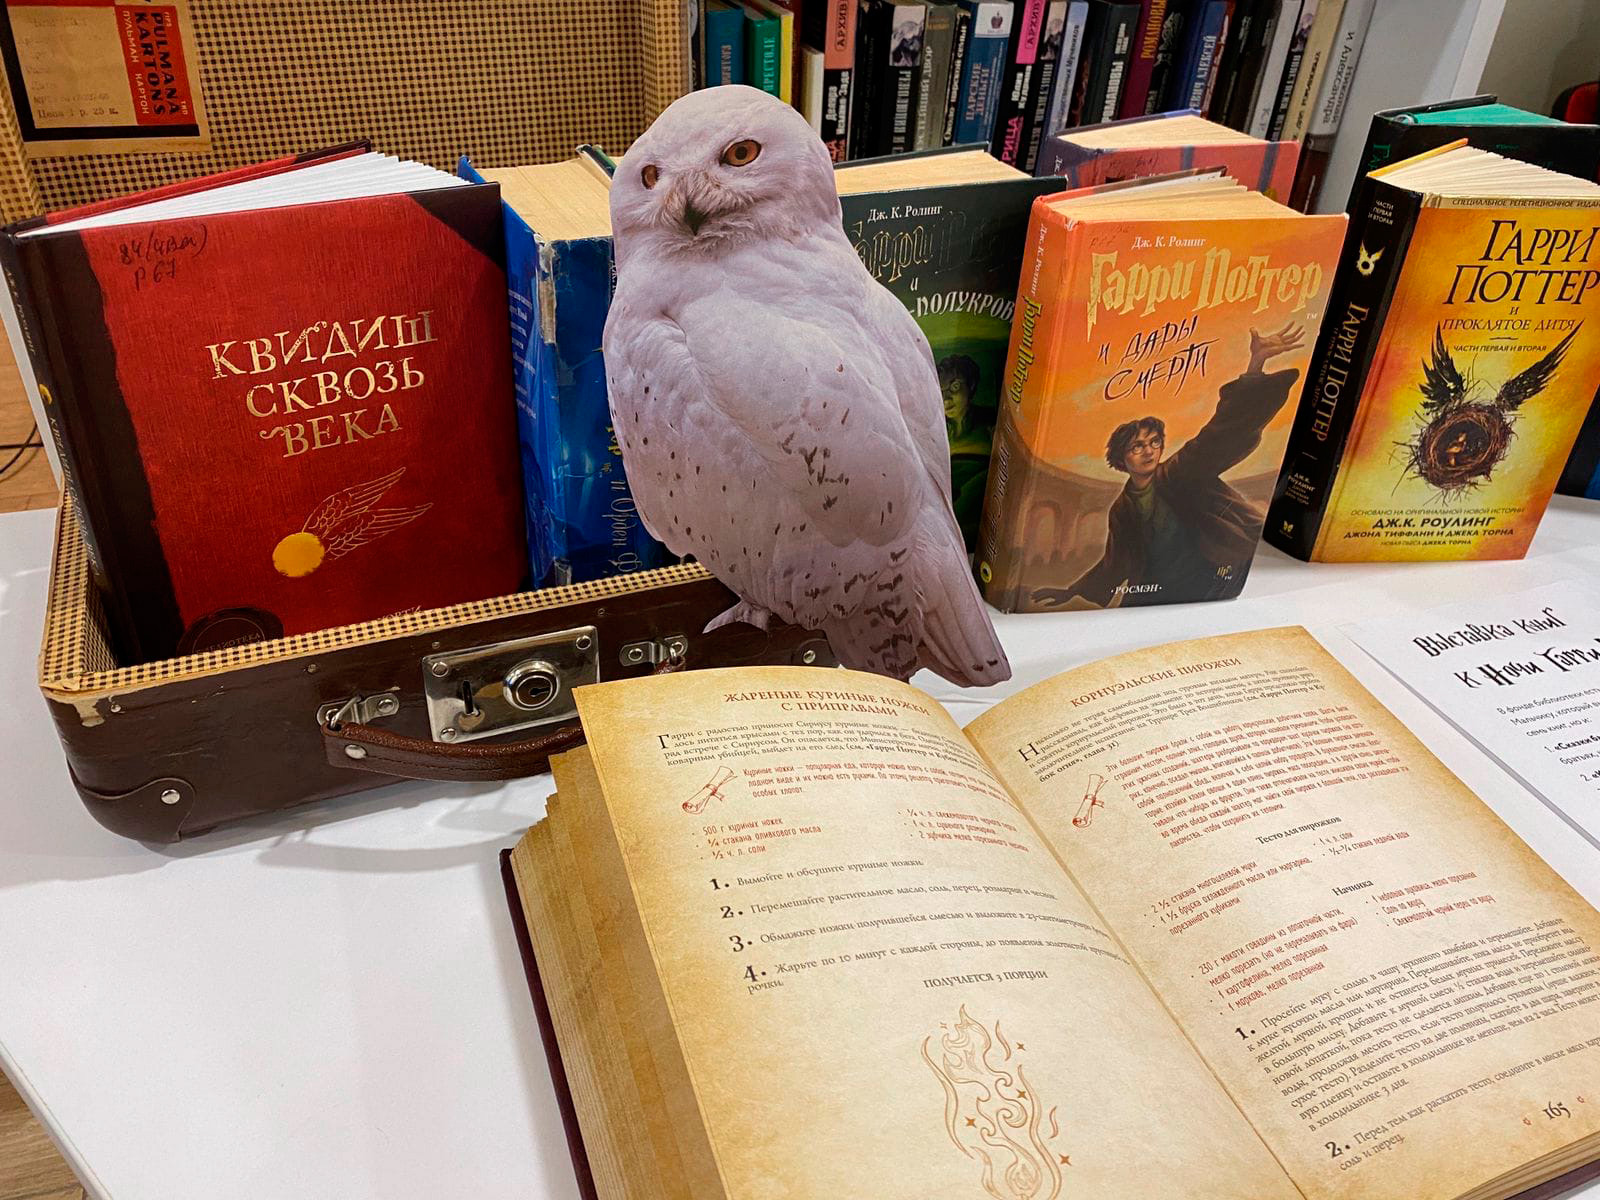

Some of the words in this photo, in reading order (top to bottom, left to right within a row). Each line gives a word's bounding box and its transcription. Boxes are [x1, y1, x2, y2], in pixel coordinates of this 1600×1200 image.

[123, 10, 139, 63] ПУЛЬМАН
[135, 12, 166, 115] KARTONS
[151, 12, 180, 115] PULMANA
[135, 73, 149, 114] КАРТОН
[1322, 44, 1353, 125] Александра
[867, 209, 888, 223] Дж.
[890, 206, 902, 219] К.
[905, 205, 943, 218] Ролинг
[1131, 236, 1153, 249] Дж.
[1154, 236, 1166, 248] К.
[1168, 236, 1207, 248] Ролинг
[1478, 220, 1600, 265] ГАРРИ
[1086, 250, 1196, 344] Гарри
[1191, 246, 1323, 315] Поттер
[1442, 265, 1600, 304] ПОТТЕР
[1442, 319, 1531, 331] ПРОКЛЯТОЕ
[1534, 319, 1575, 332] ДИТЯ
[1509, 306, 1519, 315] И
[204, 309, 438, 380] КВИДИШ
[1333, 301, 1370, 364] ГАРРИ
[246, 356, 426, 417] СКВОЗЬ
[1311, 364, 1349, 442] ПОТТЕР
[259, 403, 403, 458] ВЕКА
[1344, 531, 1381, 539] ДЖОНА
[1420, 517, 1495, 528] РОУЛИНГ
[1070, 669, 1176, 708] КОРНУЭЛЬСКИЕ
[1177, 657, 1242, 676] ПИРОЖКИ
[724, 690, 802, 703] ЖАРЕНЫЕ
[806, 690, 877, 703] КУРИНЫЕ
[880, 696, 931, 716] НОЖКИ
[781, 702, 793, 711] С
[797, 702, 898, 717] ПРИПРАВАМИ
[1507, 702, 1534, 713] фонде
[1533, 693, 1584, 706] библиотеки
[1526, 729, 1548, 737] семь
[702, 826, 717, 836] 500
[728, 823, 759, 836] куриных
[762, 818, 783, 827] ножек
[722, 835, 752, 845] стакана
[755, 828, 797, 841] оливкового
[800, 825, 822, 833] масла
[1255, 832, 1283, 845] Тесто
[1283, 828, 1299, 838] для
[1299, 816, 1342, 832] пирожков
[709, 878, 730, 891] 1.
[736, 874, 783, 887] Вымойте
[796, 864, 845, 879] обсушите
[848, 860, 889, 872] куриные
[891, 859, 924, 867] ножки.
[1332, 880, 1374, 897] Начинка
[720, 906, 744, 919] 2.
[750, 896, 825, 914] Перемешайте
[828, 888, 894, 905] растительное
[897, 885, 928, 896] масло,
[729, 935, 753, 953] 3.
[760, 928, 816, 944] Обмажьте
[819, 922, 854, 934] ножки
[857, 914, 927, 929] получившейся
[743, 965, 767, 983] 4.
[776, 960, 818, 975] Жарьте
[855, 950, 887, 962] минут
[900, 942, 937, 954] каждой
[940, 940, 983, 951] стороны,
[747, 981, 784, 995] рочки.
[923, 973, 994, 989] ПОЛУЧАЕТСЯ
[1003, 970, 1049, 980] ПОРЦИИ
[1235, 1027, 1255, 1040] 1.
[1260, 1002, 1307, 1029] Просейте
[1324, 1141, 1350, 1159] 2.
[1353, 1124, 1389, 1144] Перед
[1388, 1115, 1408, 1128] тем
[1407, 1106, 1426, 1119] как
[1425, 1088, 1469, 1113] раскатать
[1542, 1101, 1571, 1121] 165
[1340, 1156, 1362, 1171] соль
[1373, 1134, 1405, 1154] перец.
